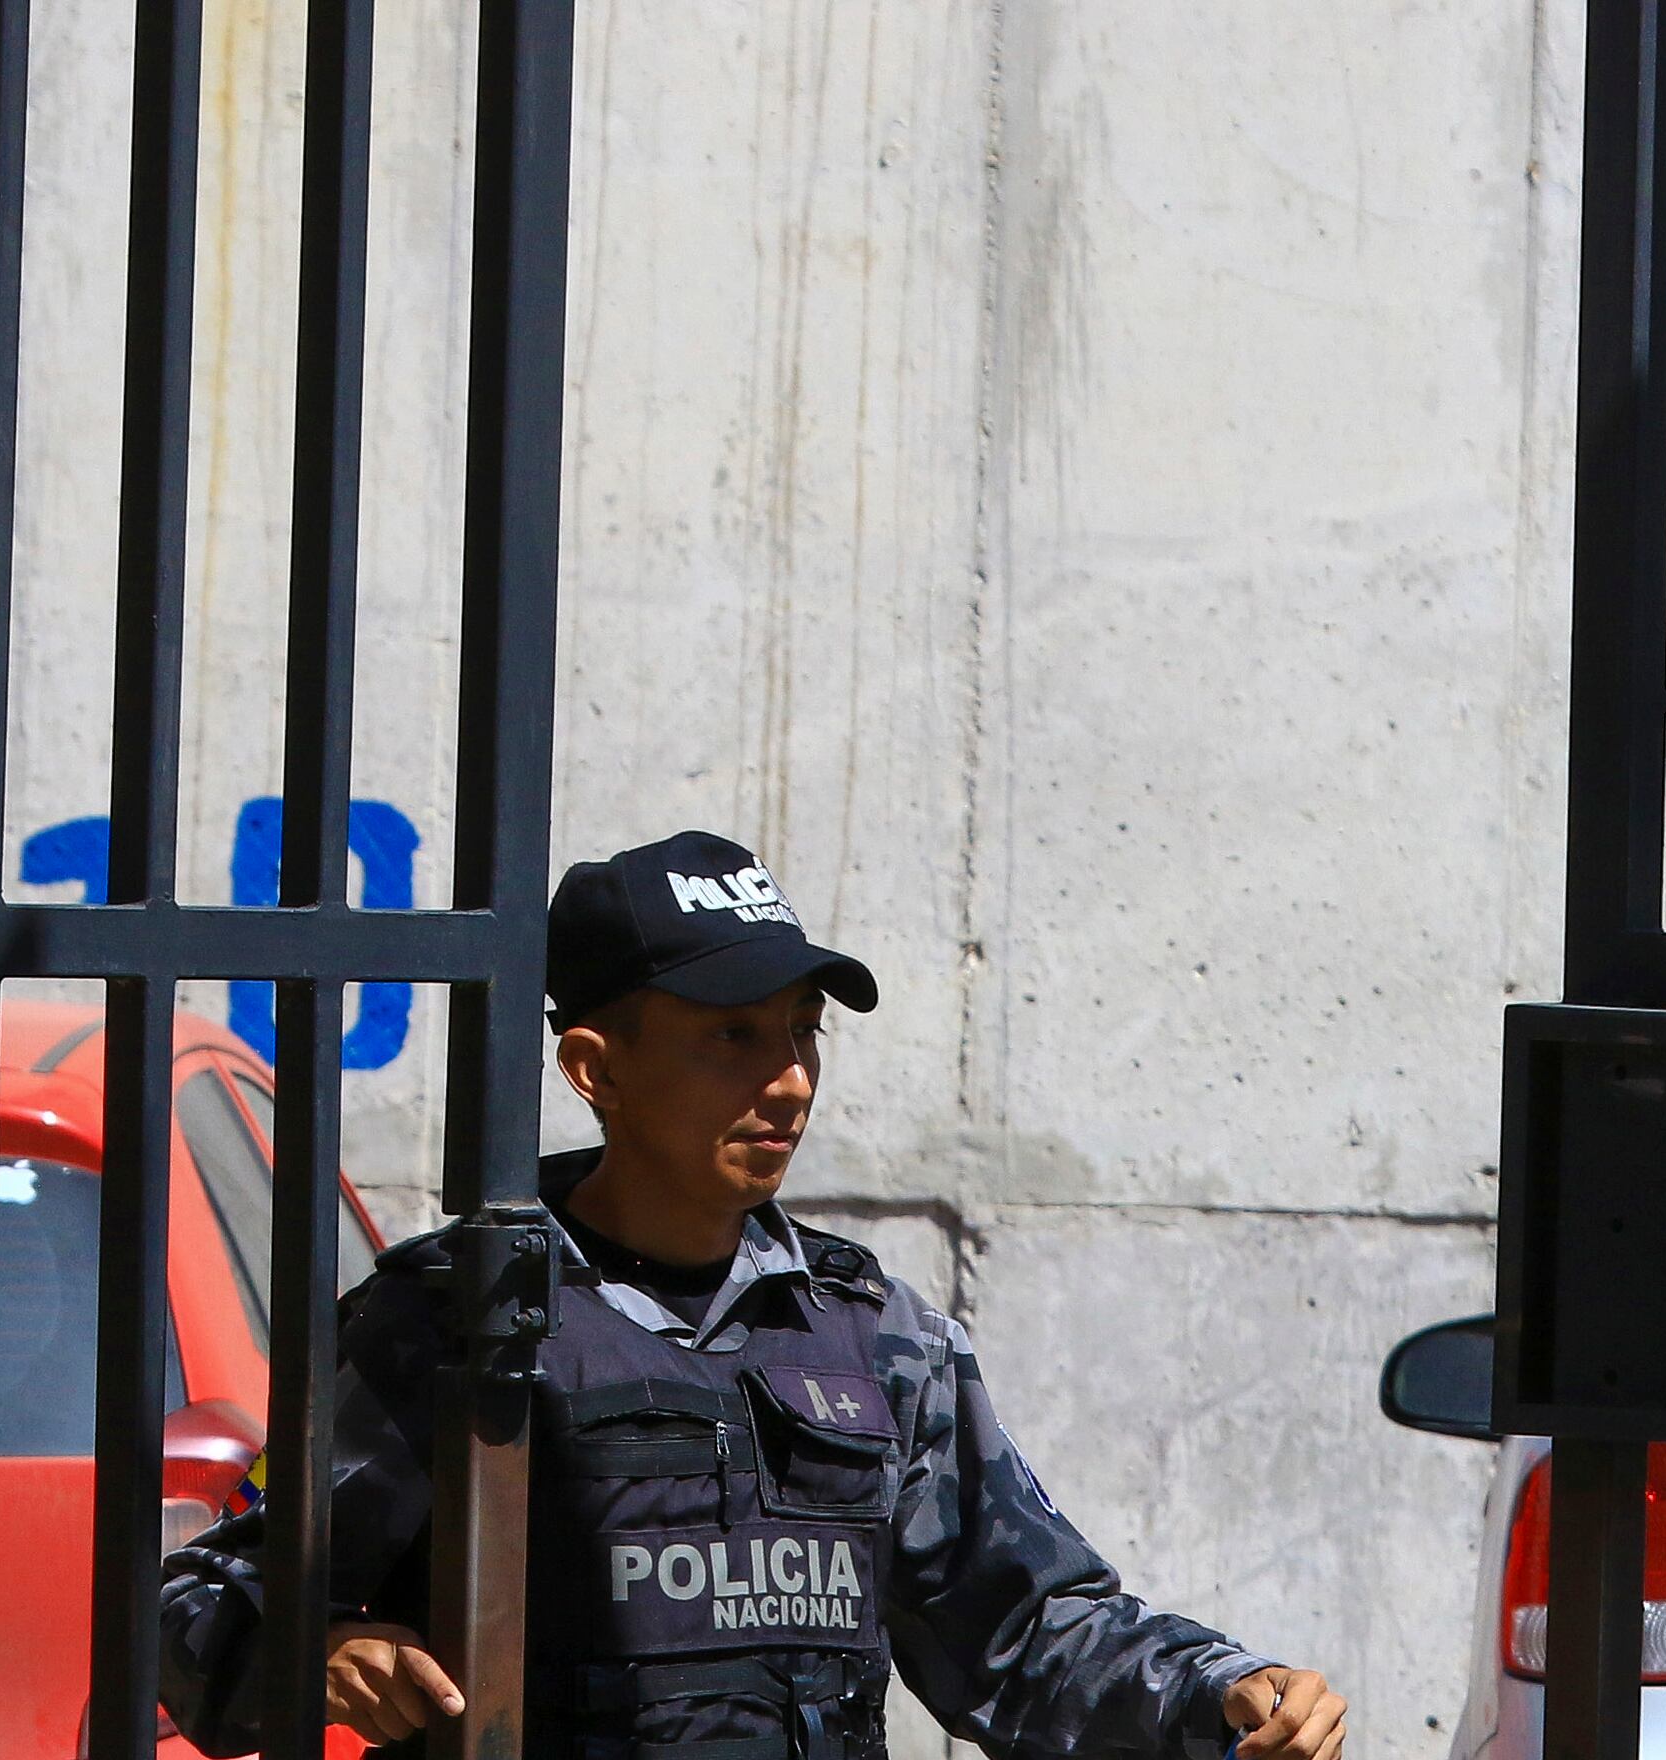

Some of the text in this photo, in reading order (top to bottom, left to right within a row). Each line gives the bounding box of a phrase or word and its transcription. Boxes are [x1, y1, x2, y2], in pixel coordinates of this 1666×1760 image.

[802, 1378, 862, 1425] A+
[610, 1537, 863, 1602] POLICIA
[713, 1594, 860, 1630] NACIONAL
